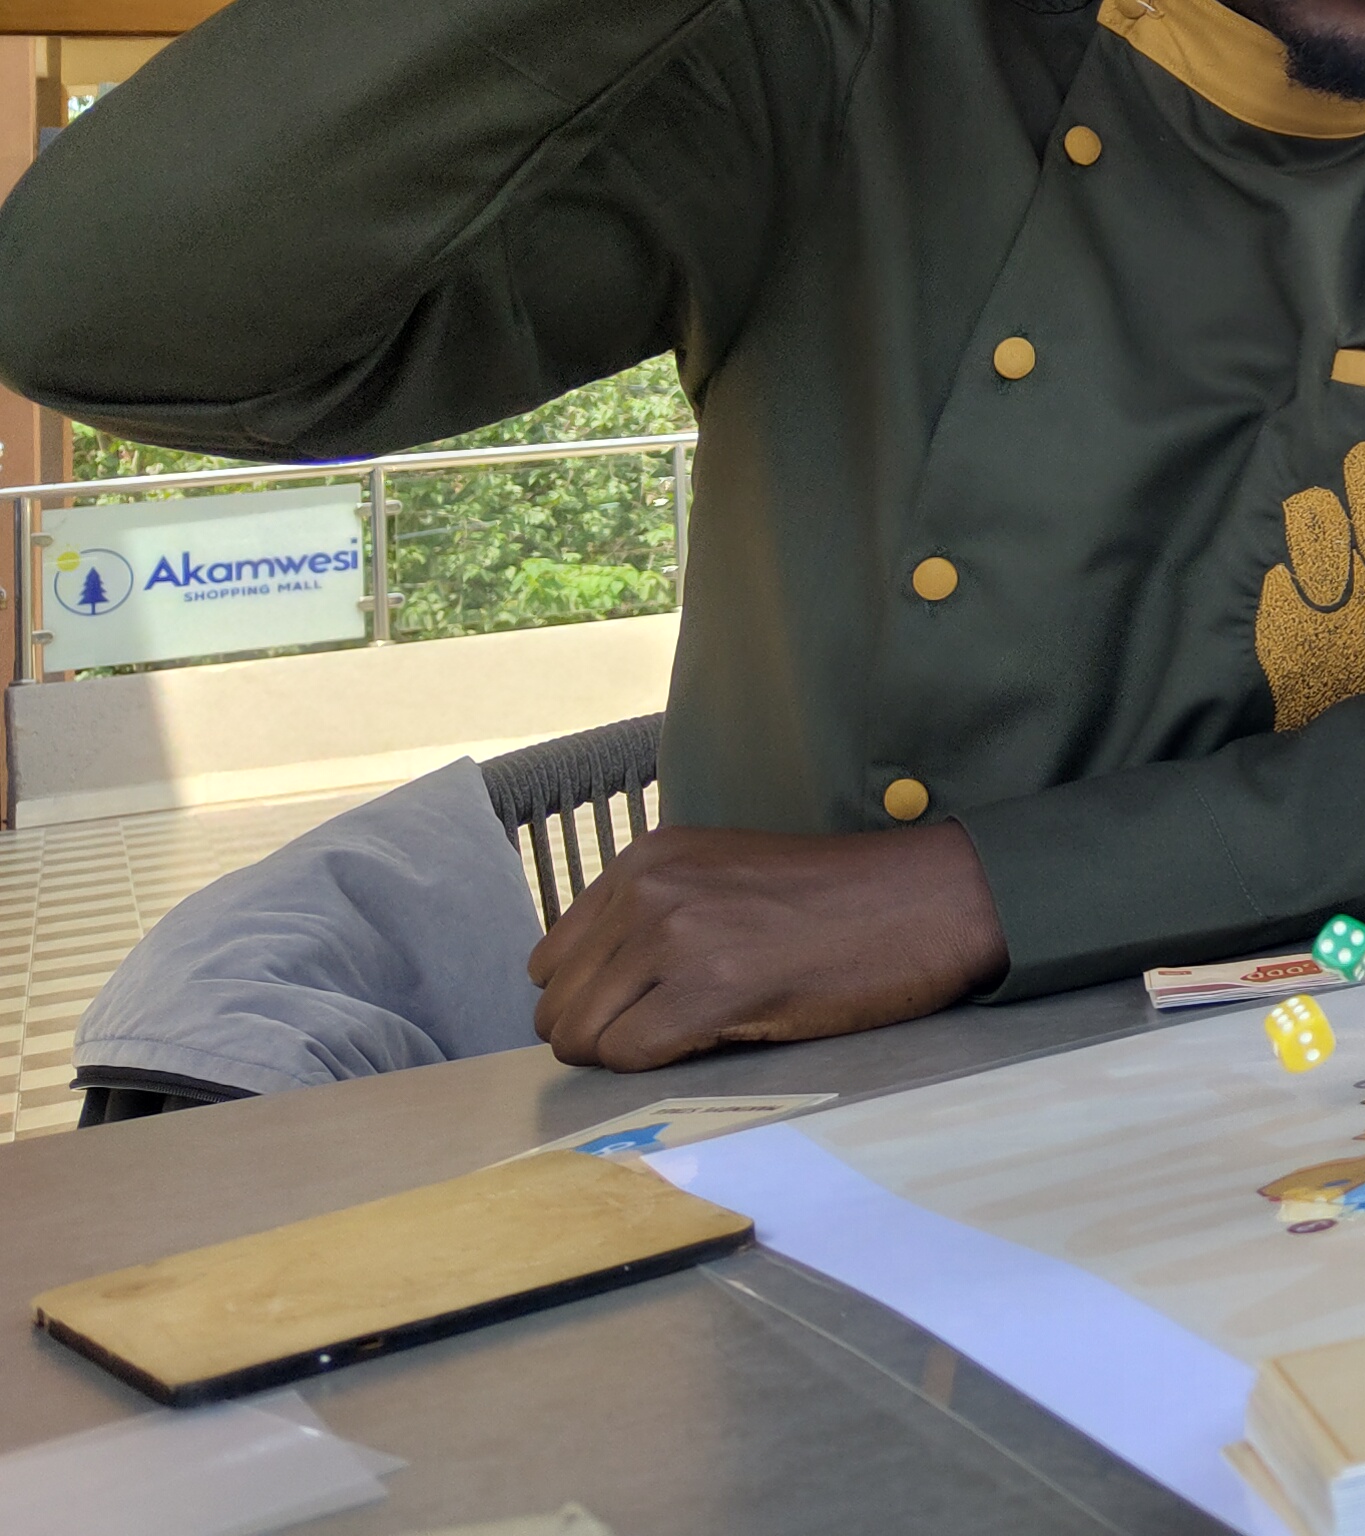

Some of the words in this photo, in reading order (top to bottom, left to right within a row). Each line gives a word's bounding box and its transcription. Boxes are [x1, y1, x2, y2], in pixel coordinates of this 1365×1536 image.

[143, 537, 358, 591] Akamwesi
[183, 584, 271, 603] SHOPPING
[277, 580, 323, 593] MALL
